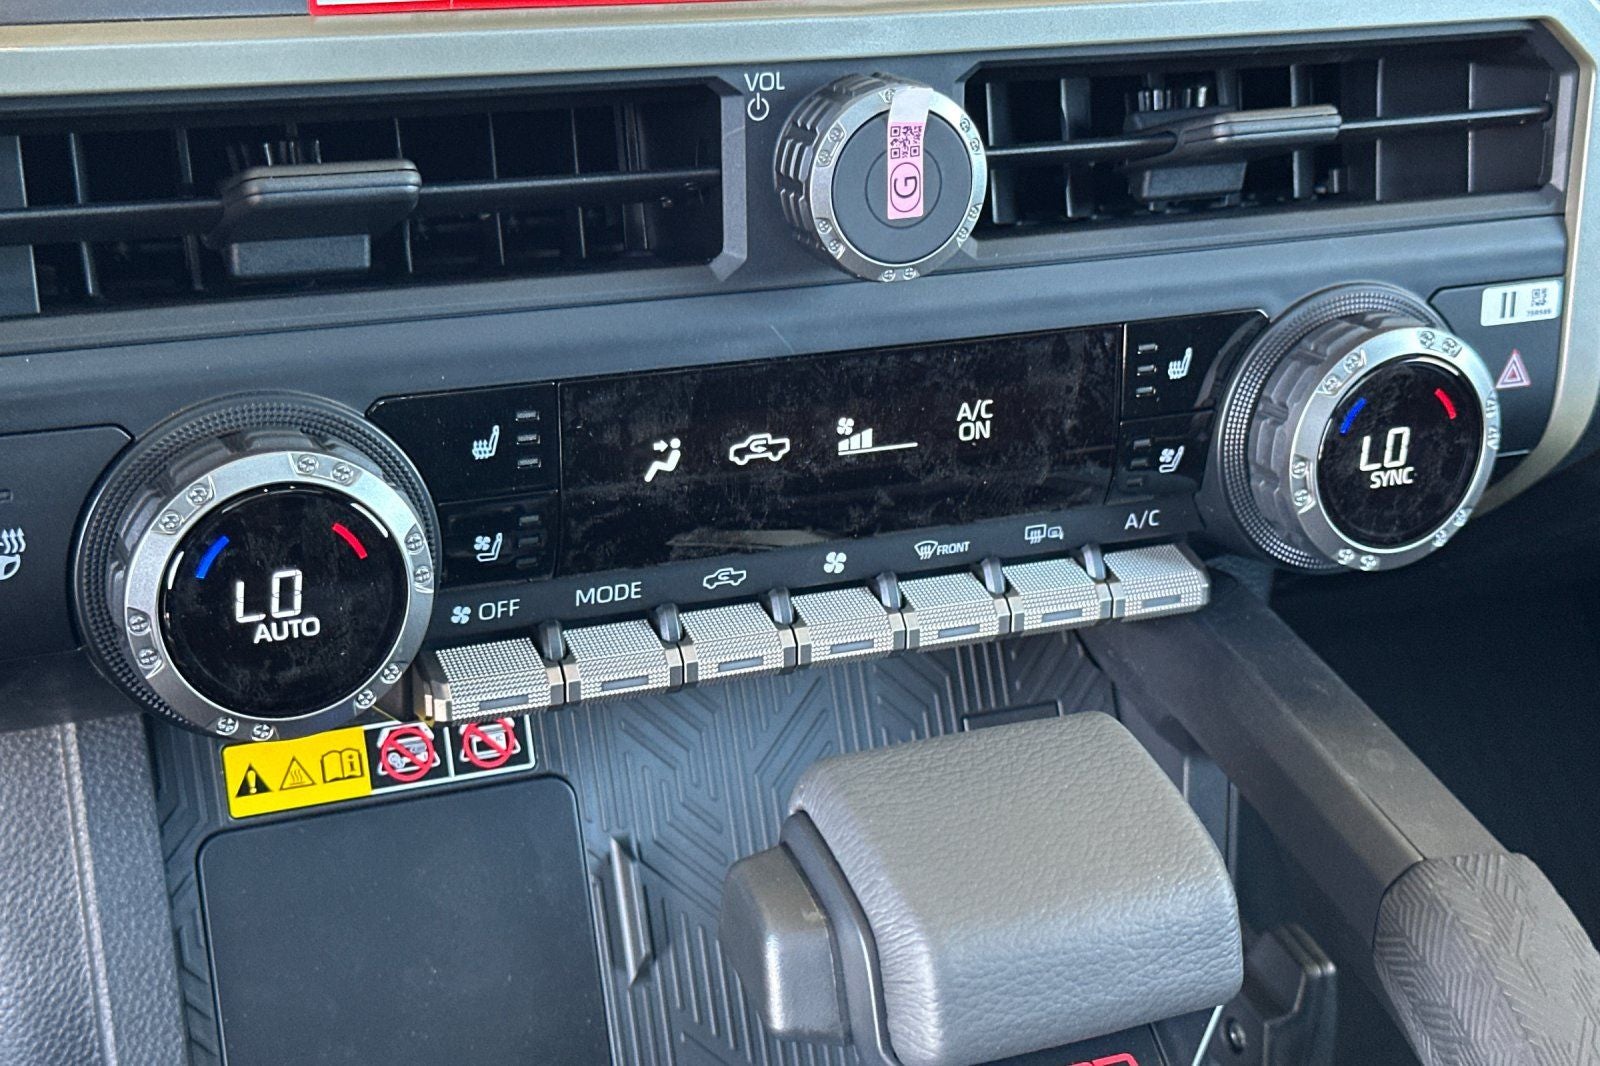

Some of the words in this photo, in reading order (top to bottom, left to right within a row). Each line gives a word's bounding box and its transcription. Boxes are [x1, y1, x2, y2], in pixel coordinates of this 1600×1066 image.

[744, 71, 785, 92] VOL
[956, 399, 994, 421] A/C
[958, 420, 991, 441] ON
[1369, 466, 1414, 489] SYNC
[1124, 509, 1161, 531] A/C
[936, 541, 971, 556] FRONT
[575, 581, 643, 607] MODE
[478, 599, 521, 621] OFF
[253, 617, 321, 644] AUTO
